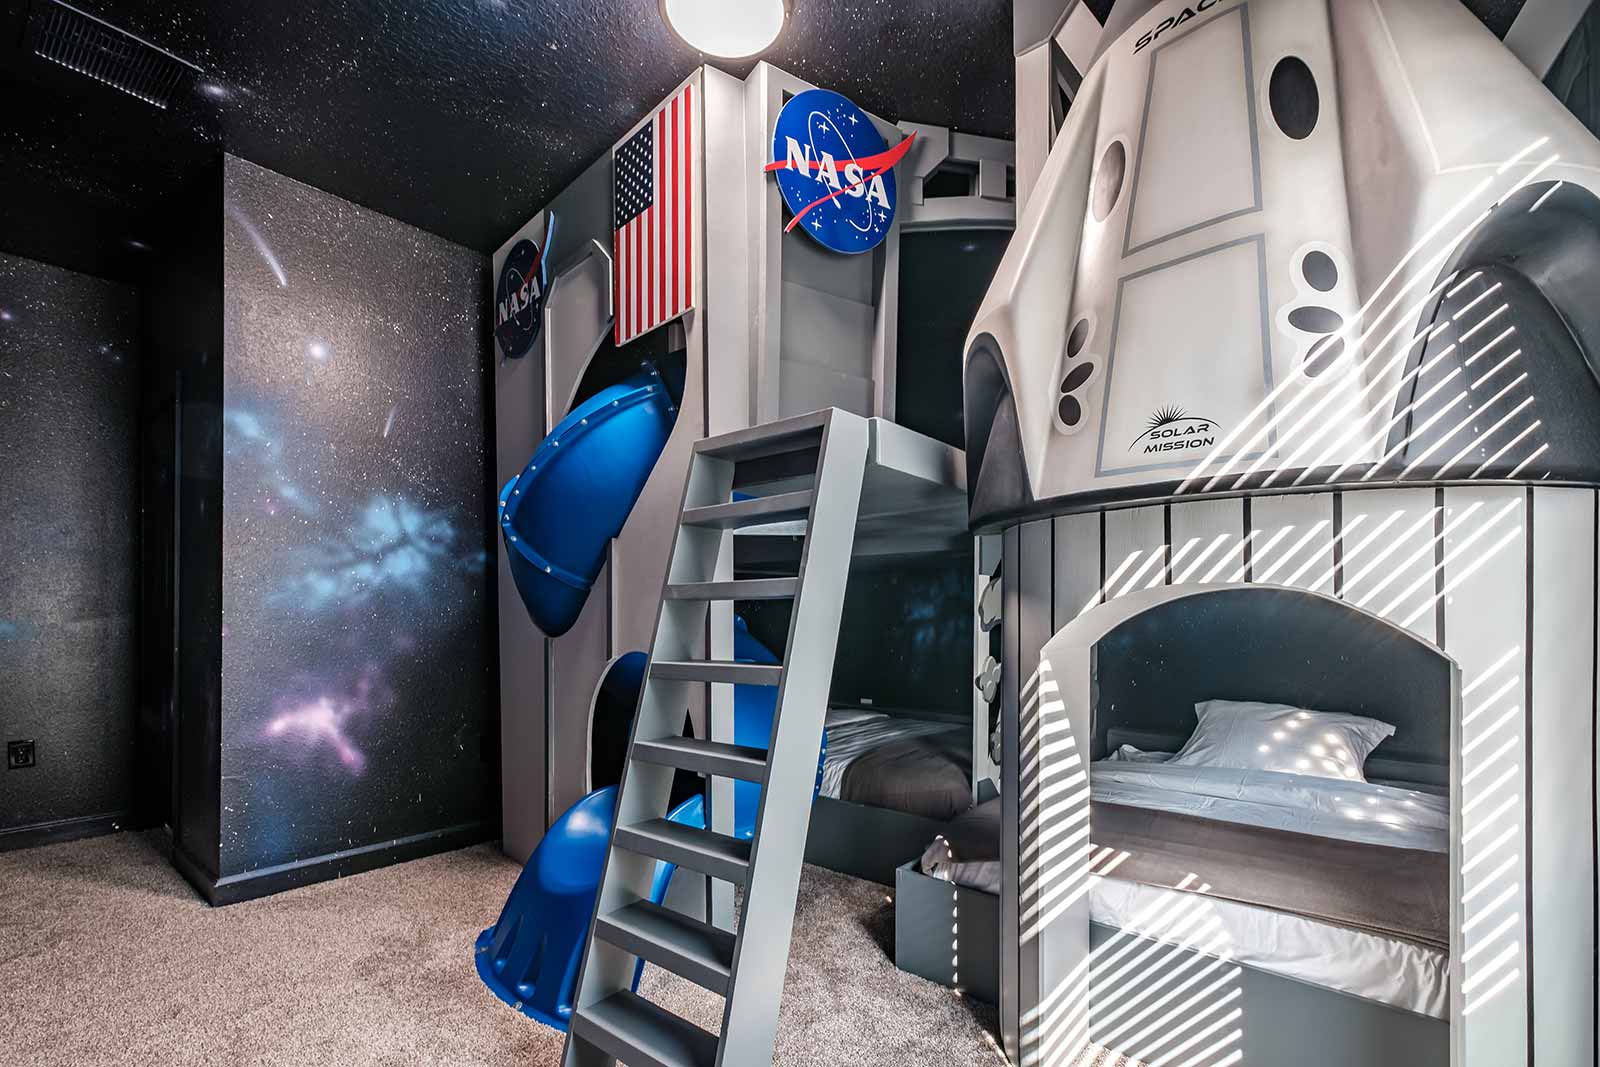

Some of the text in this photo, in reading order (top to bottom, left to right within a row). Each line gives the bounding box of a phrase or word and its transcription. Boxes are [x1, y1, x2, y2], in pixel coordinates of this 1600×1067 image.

[1133, 0, 1222, 55] SPAC
[785, 135, 891, 209] NASA
[499, 275, 541, 326] NASA
[1143, 437, 1215, 454] MISSION
[1150, 423, 1210, 440] SOLAR
